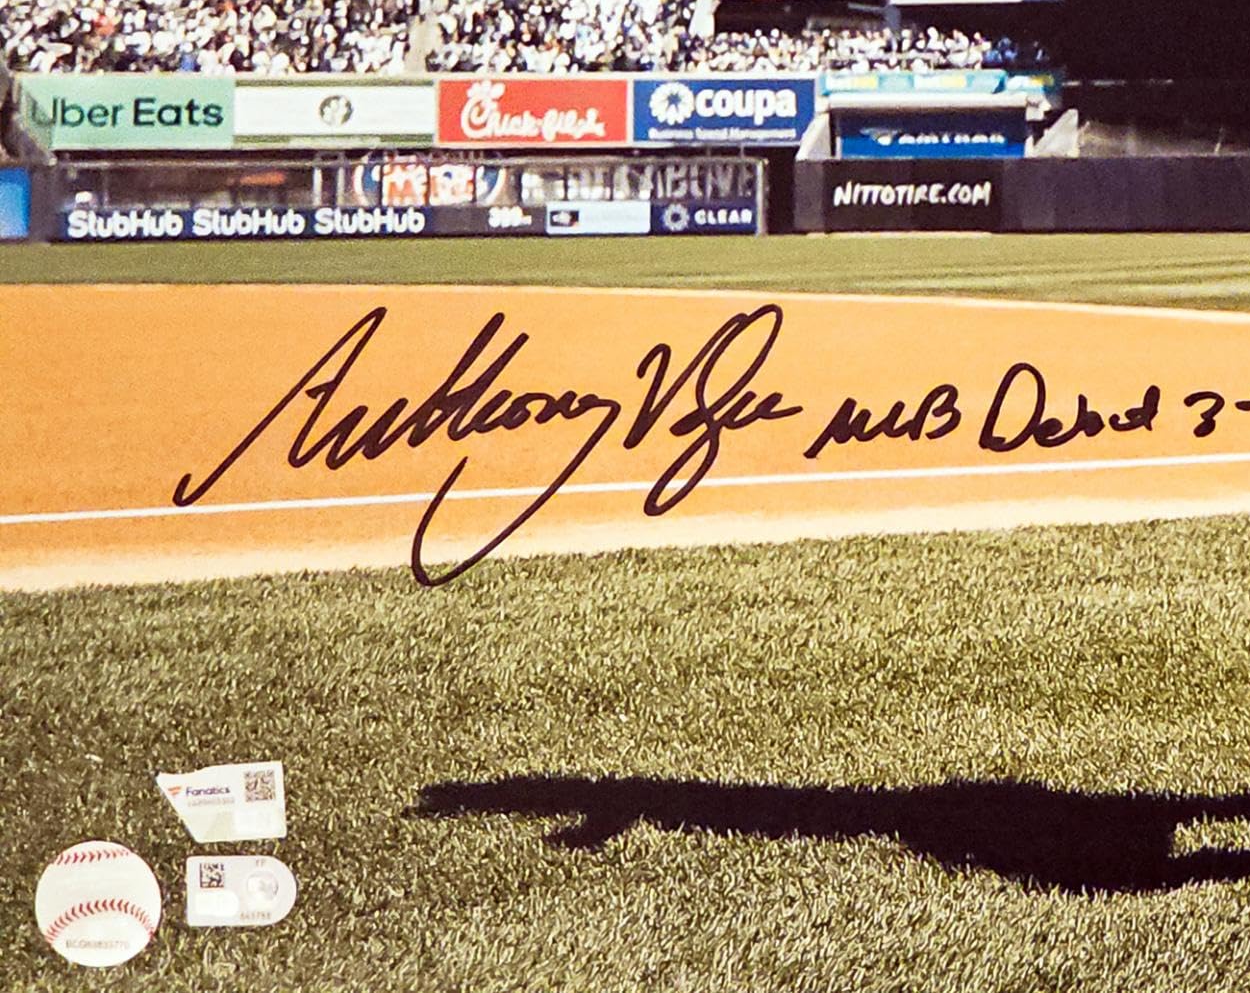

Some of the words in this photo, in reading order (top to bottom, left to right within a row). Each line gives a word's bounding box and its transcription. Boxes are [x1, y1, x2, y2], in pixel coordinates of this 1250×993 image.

[133, 97, 224, 127] Eats
[695, 88, 797, 125] coupa
[67, 209, 184, 238] StubHub
[192, 208, 305, 237] StubHub
[313, 207, 426, 235] StubHub
[694, 207, 753, 225] CLEAR
